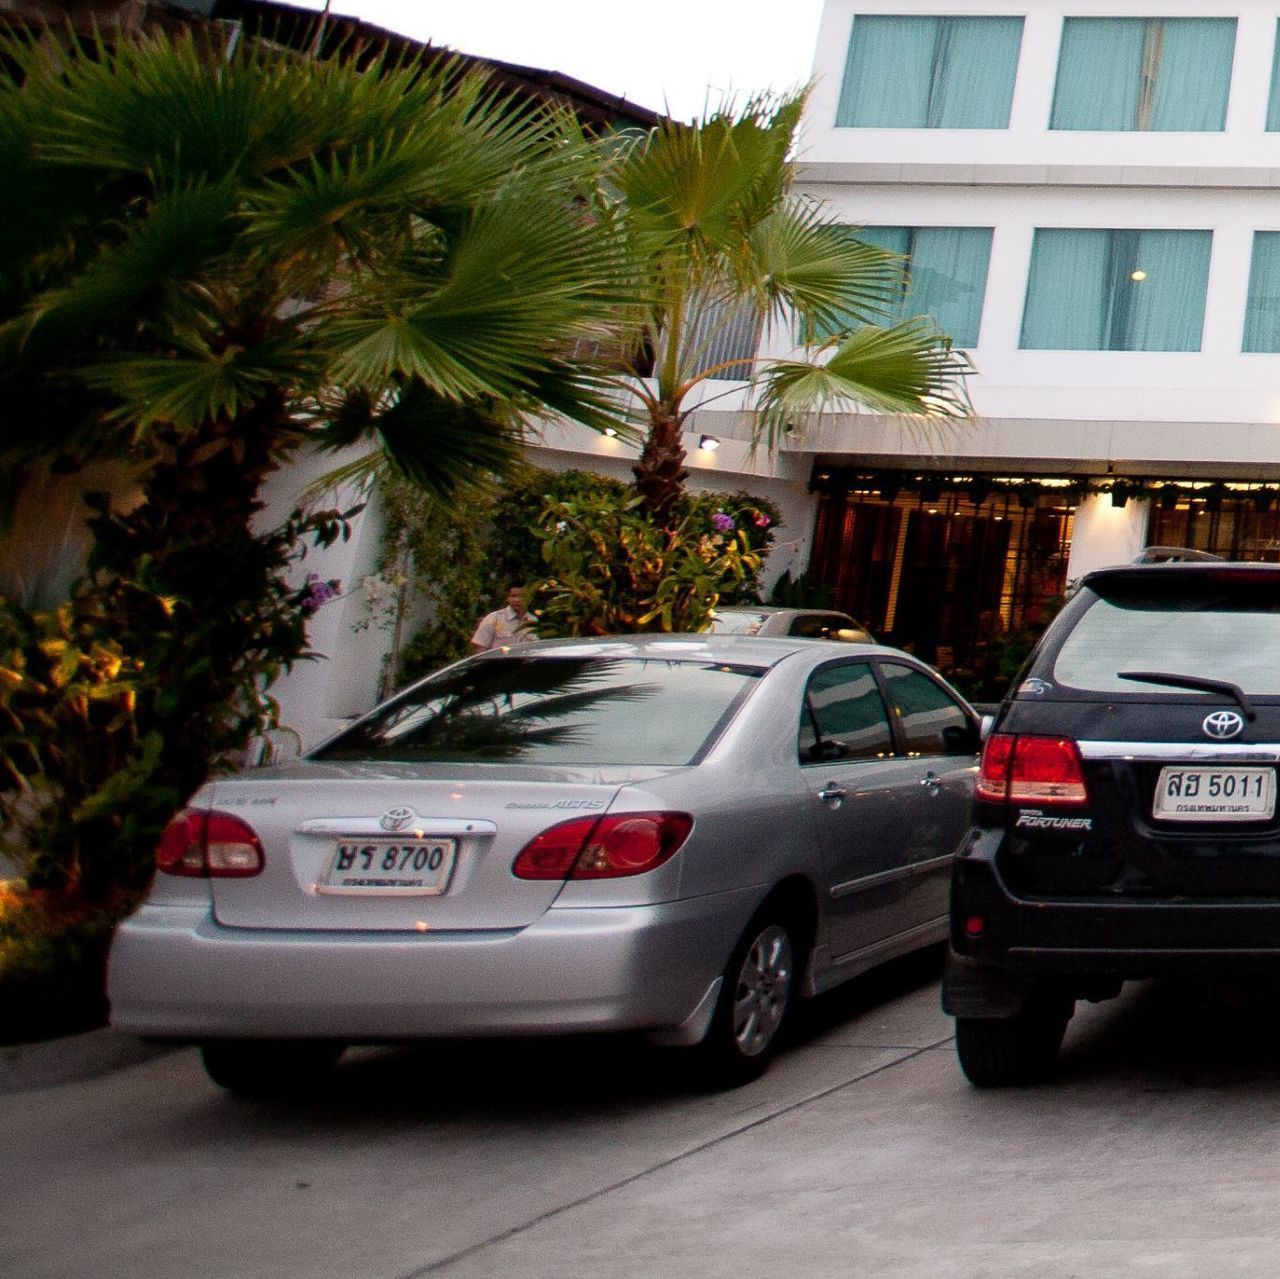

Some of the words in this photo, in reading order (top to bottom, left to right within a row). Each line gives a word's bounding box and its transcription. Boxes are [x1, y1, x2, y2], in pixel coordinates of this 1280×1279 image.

[1208, 774, 1264, 798] 5011
[1016, 816, 1093, 830] FORTUNER
[382, 846, 444, 870] 8700
